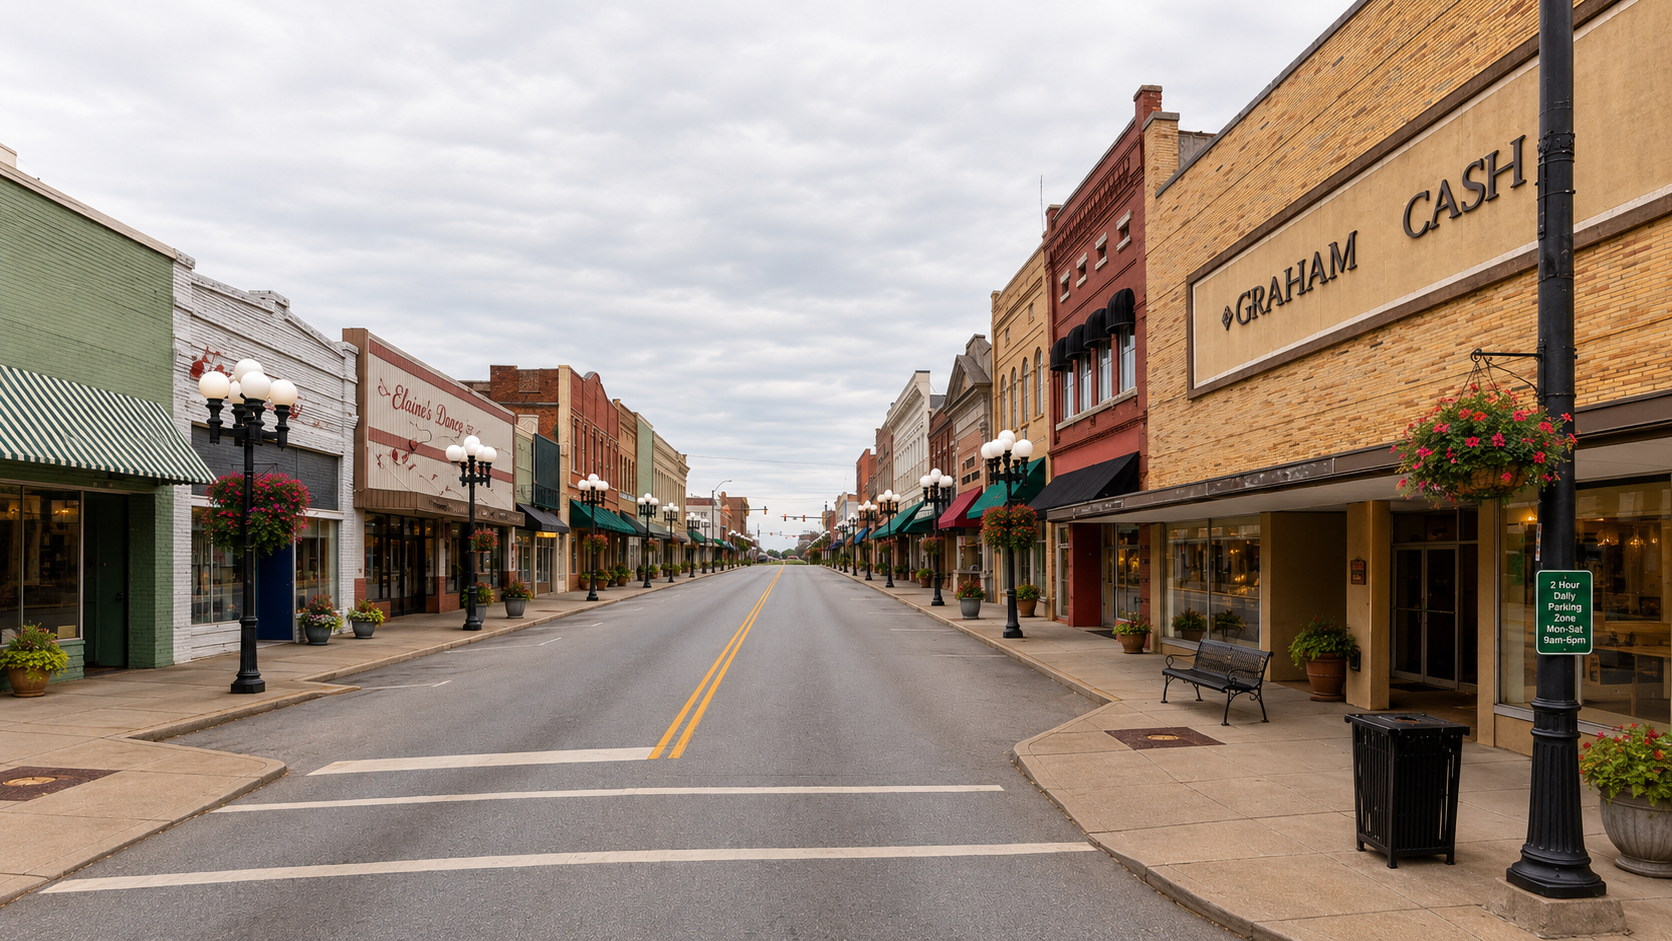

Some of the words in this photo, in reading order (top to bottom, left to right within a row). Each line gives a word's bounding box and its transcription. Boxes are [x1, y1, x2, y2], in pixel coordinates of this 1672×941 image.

[1235, 230, 1358, 325] GRAHAM
[1402, 134, 1527, 239] CASH
[392, 384, 432, 421] Elaine's
[1550, 581, 1556, 589] 2
[1558, 581, 1580, 589] Hour
[1554, 592, 1576, 602] Daily
[1548, 603, 1582, 613] Parking
[1546, 625, 1583, 633] Mon-Sat
[1544, 636, 1586, 646] 9am-6pm
